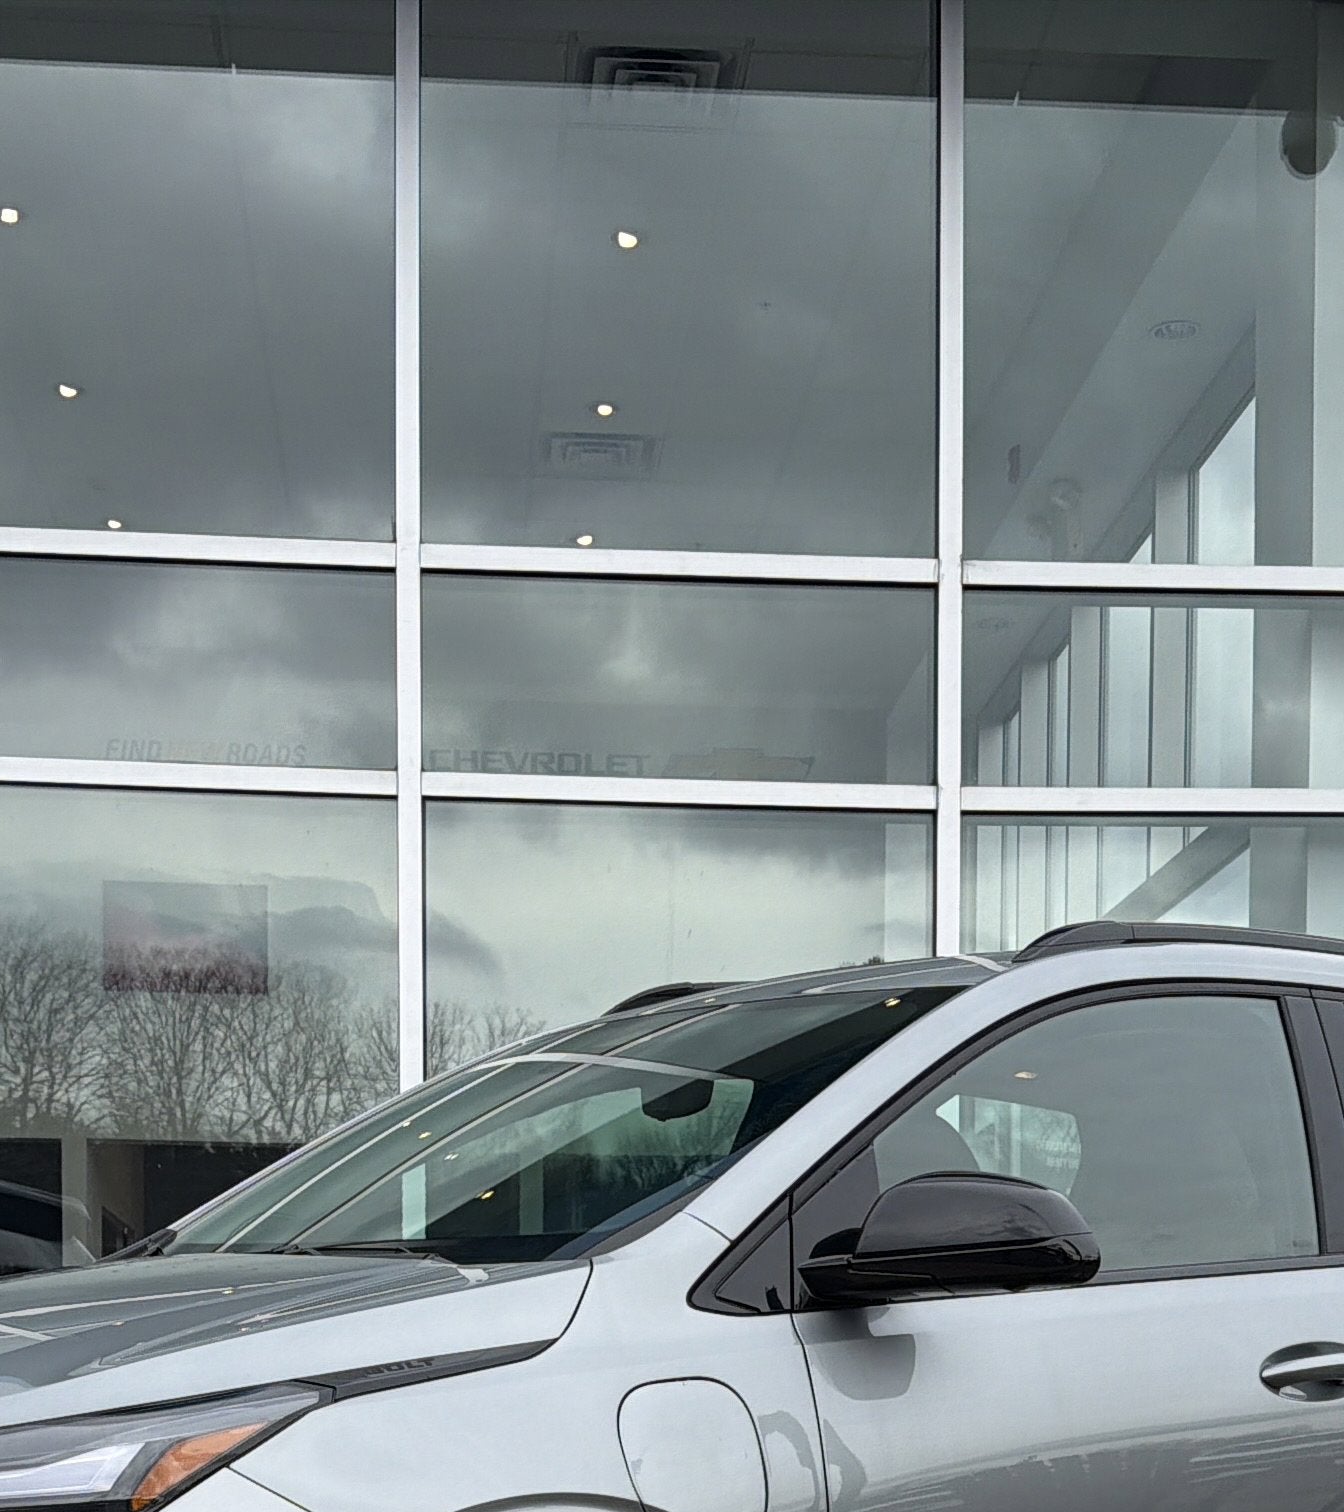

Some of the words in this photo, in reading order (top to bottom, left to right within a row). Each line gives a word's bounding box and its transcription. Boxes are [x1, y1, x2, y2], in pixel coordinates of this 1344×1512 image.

[106, 738, 162, 761] FIND
[226, 742, 306, 765] ROADS
[429, 749, 650, 776] CHEVROLET
[365, 1357, 435, 1375] BOLT
